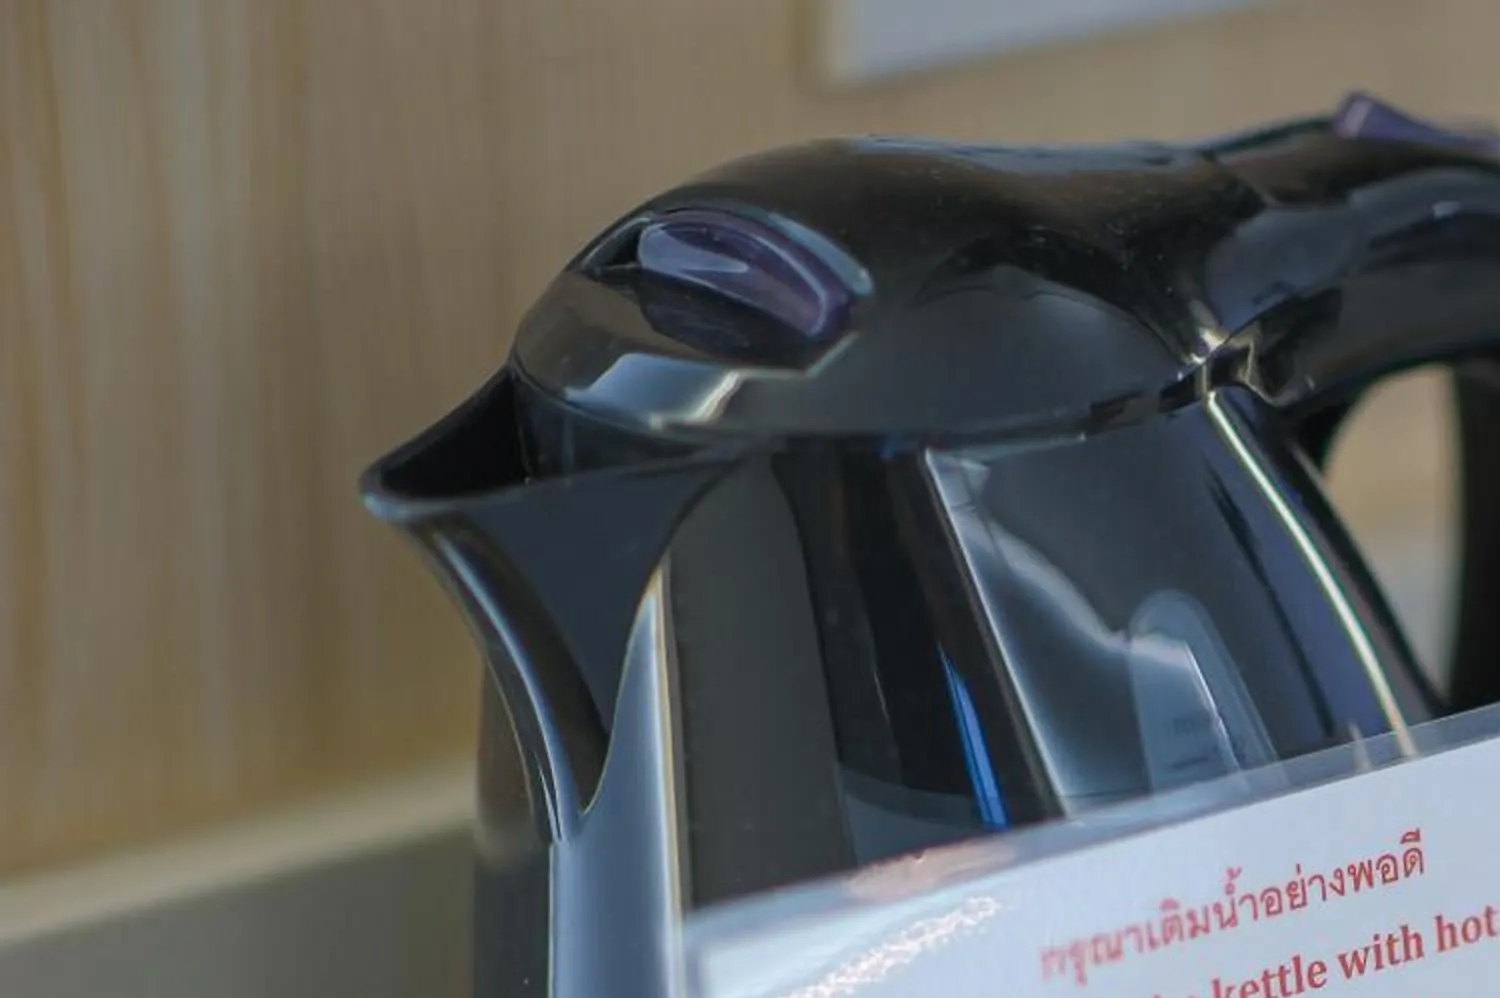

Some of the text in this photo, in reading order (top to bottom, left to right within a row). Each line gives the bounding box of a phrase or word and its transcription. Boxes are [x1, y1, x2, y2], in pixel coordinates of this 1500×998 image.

[1040, 828, 1425, 987] กรุณาเติมน้ำอย่างพอดี
[1337, 925, 1425, 979] with
[1434, 905, 1500, 953] hot
